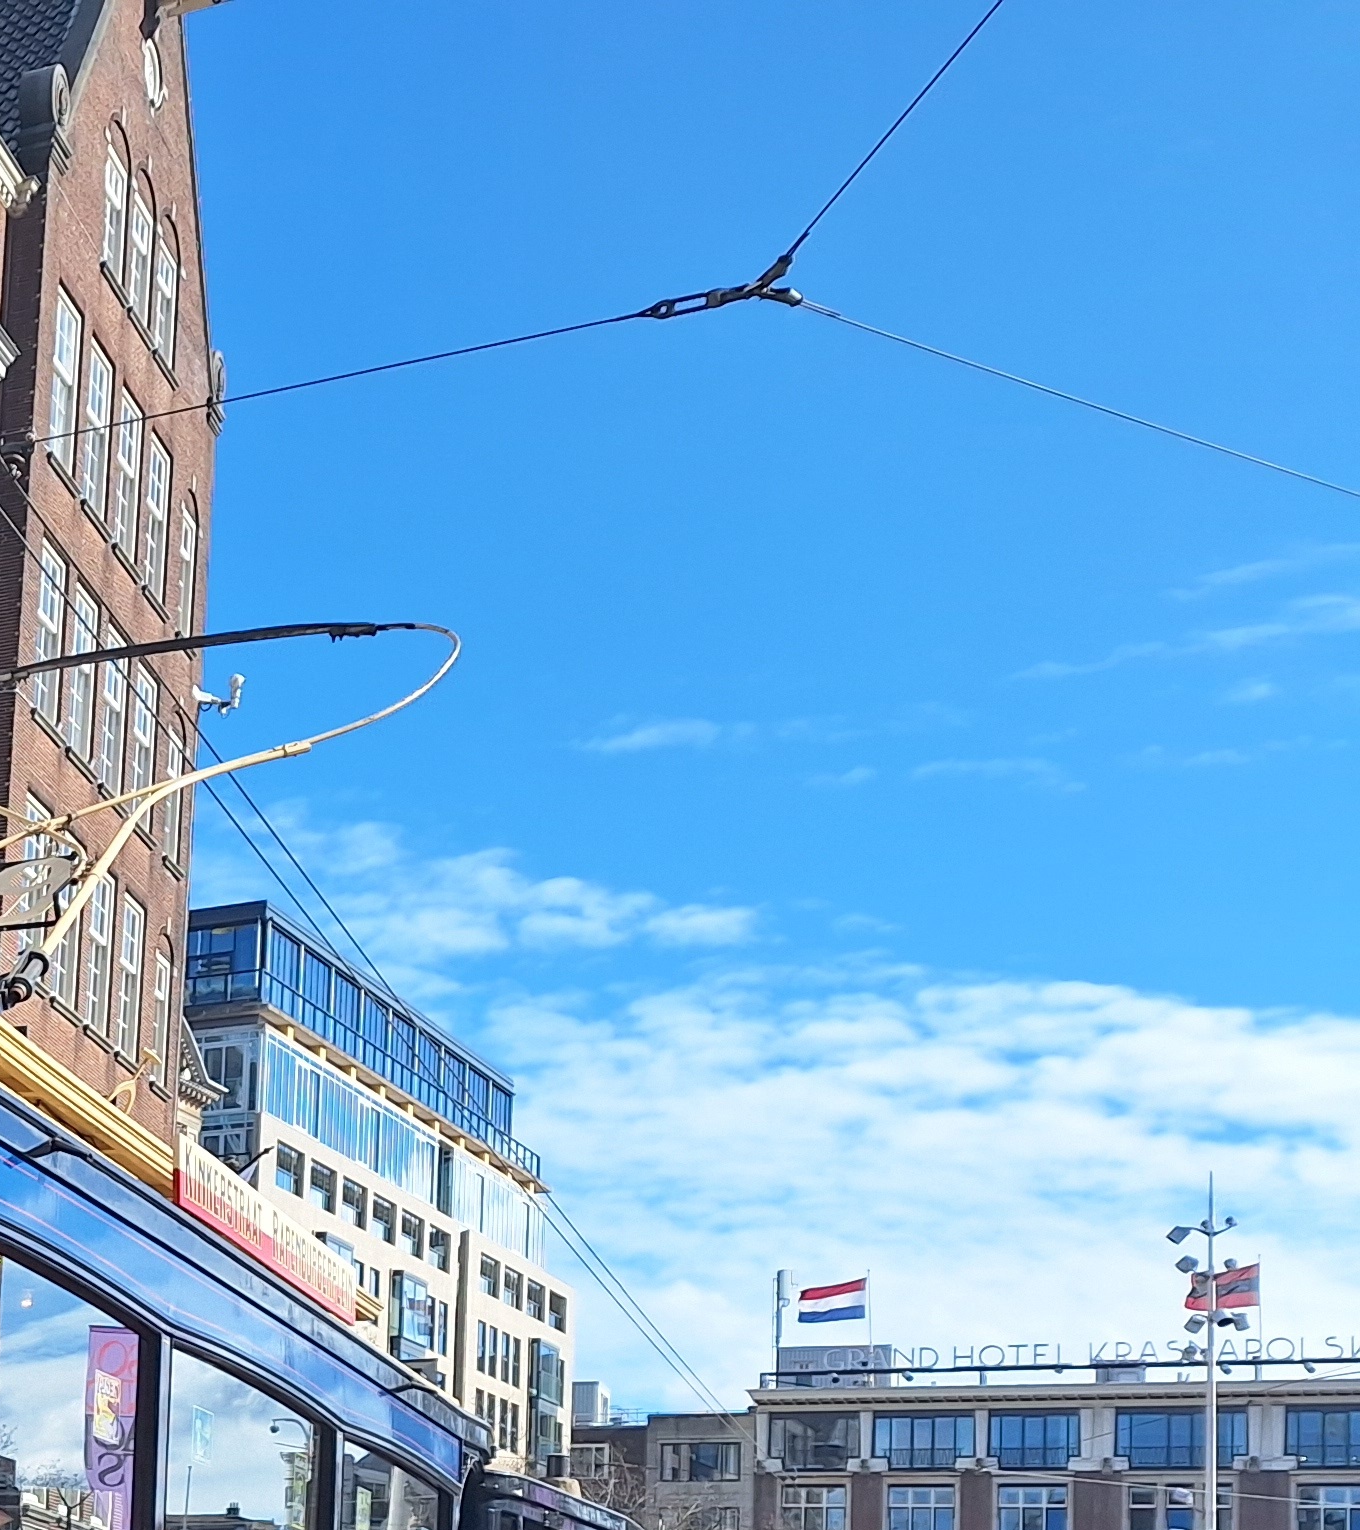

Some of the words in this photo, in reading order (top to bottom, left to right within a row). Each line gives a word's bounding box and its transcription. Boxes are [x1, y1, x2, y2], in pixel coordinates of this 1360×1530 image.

[185, 1142, 263, 1250] KINKERSTRAAT
[823, 1346, 939, 1370] GRAND
[954, 1343, 1073, 1368] HOTEL
